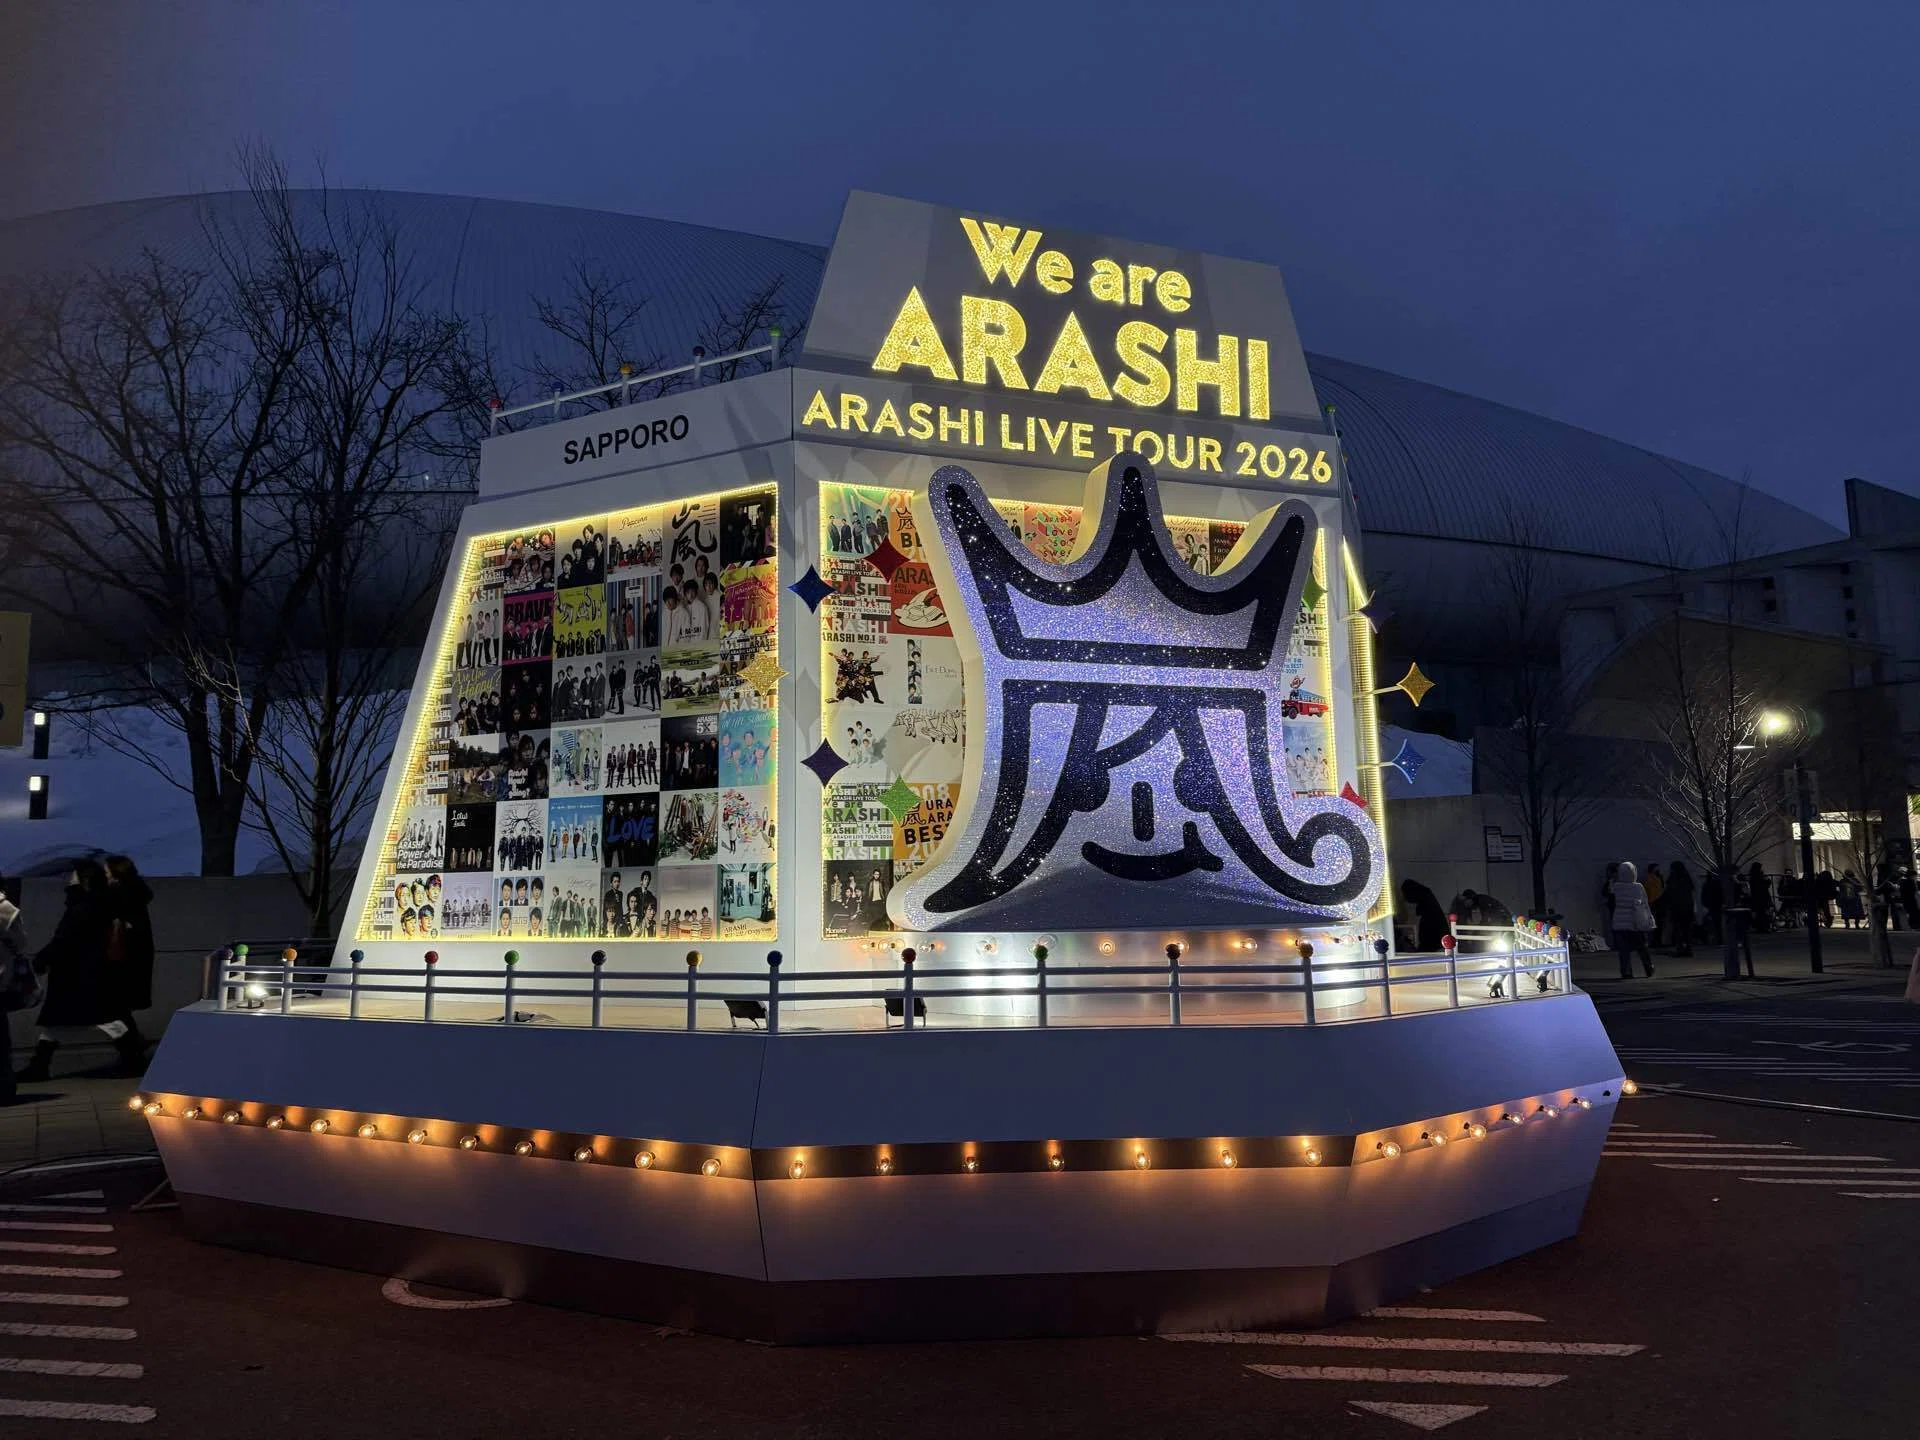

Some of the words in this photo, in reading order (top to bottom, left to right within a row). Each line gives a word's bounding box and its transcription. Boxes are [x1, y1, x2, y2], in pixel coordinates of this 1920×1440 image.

[960, 217, 1074, 294] We
[1089, 257, 1192, 313] are
[872, 285, 1271, 420] ARASHI
[564, 415, 689, 464] SAPPORO
[802, 389, 984, 446] ARASHI
[1000, 413, 1095, 459] LIVE
[1108, 426, 1223, 473] TOUR
[1235, 441, 1332, 483] 2026
[1045, 527, 1073, 537] Love
[1053, 540, 1067, 548] so
[925, 799, 953, 811] URA
[824, 807, 889, 822] ARASHI
[607, 815, 656, 841] LOVE
[904, 825, 948, 846] BES
[398, 849, 424, 860] Power
[823, 847, 890, 861] ARASHI
[407, 858, 443, 870] Paradise
